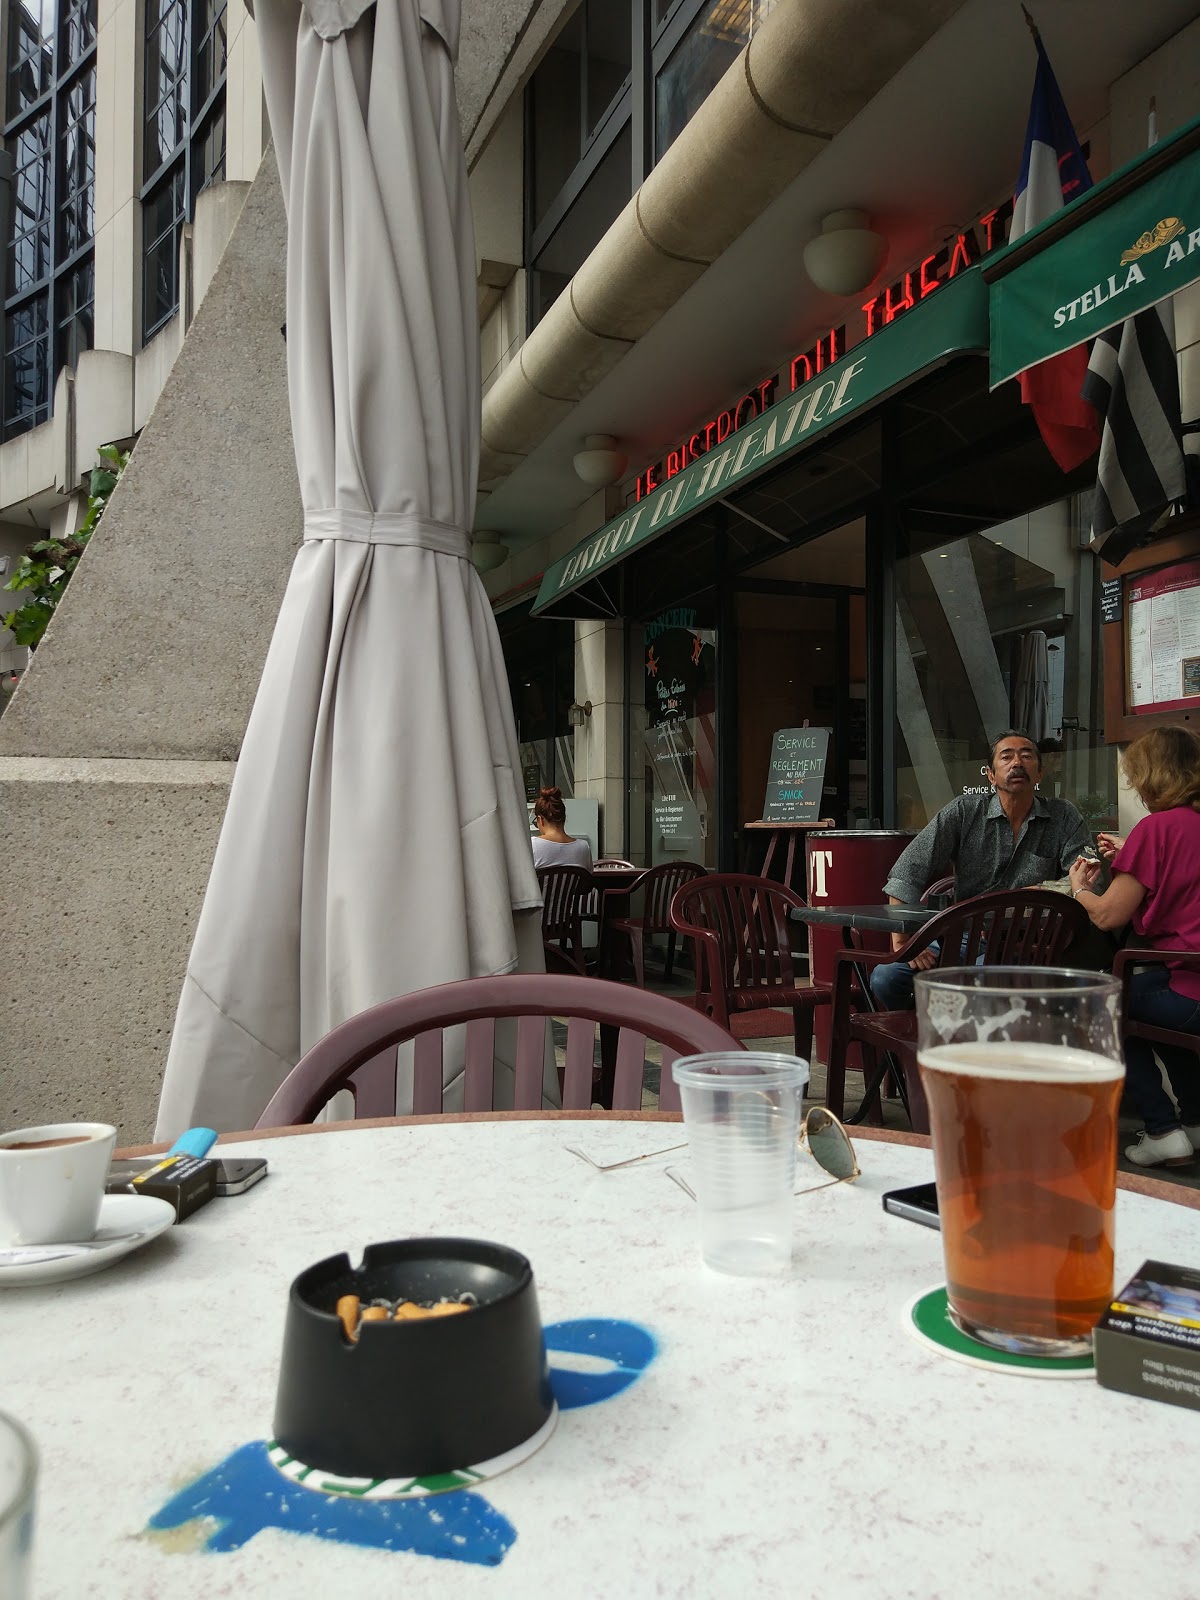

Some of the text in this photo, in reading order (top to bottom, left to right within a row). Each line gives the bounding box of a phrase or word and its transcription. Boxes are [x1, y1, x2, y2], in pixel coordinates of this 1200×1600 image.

[1053, 263, 1147, 329] STELLA
[558, 356, 867, 589] BISTROT DU THEATRE
[643, 608, 697, 646] CONCERT
[777, 734, 817, 750] SERVICE
[794, 770, 806, 779] BAR
[778, 789, 804, 801] SNACK
[963, 785, 988, 795] Service
[1107, 1318, 1133, 1332] des
[1142, 1358, 1165, 1373] Bleu
